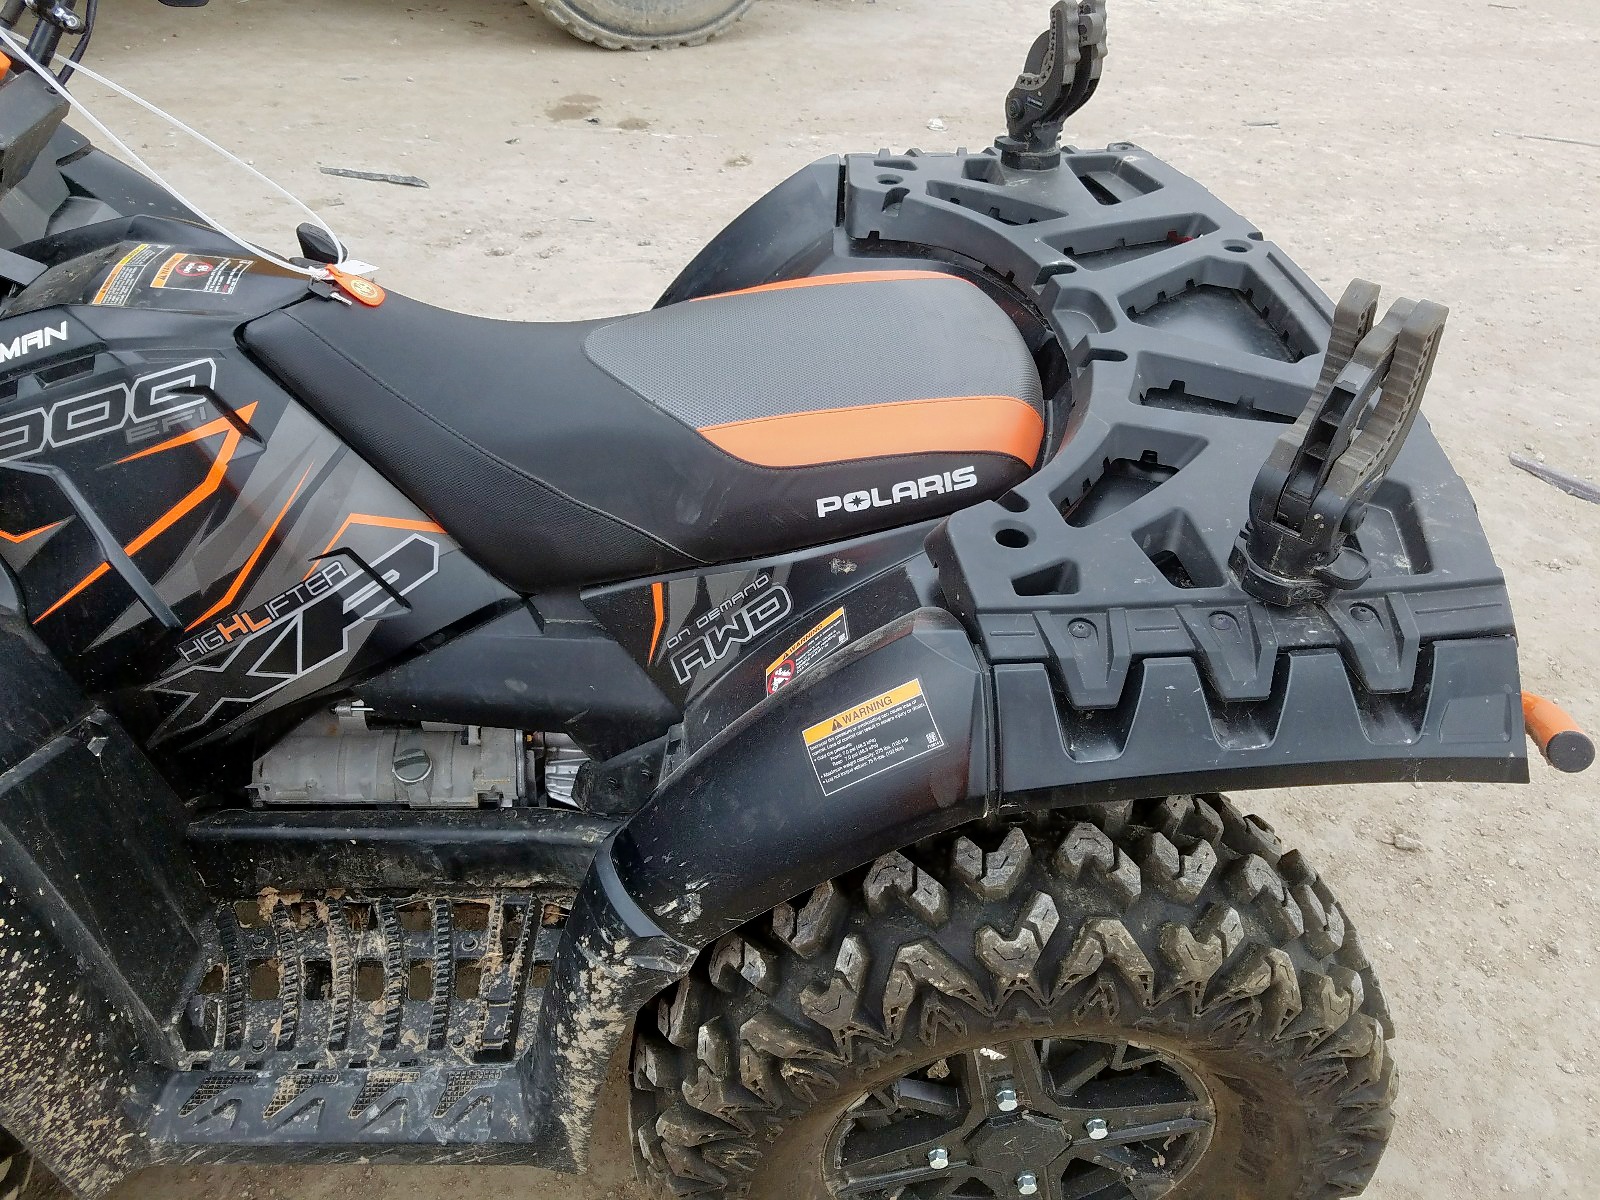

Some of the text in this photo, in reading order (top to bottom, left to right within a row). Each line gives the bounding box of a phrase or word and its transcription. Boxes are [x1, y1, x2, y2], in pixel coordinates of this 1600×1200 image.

[126, 406, 207, 444] EFI
[816, 465, 978, 518] POLARIS
[177, 559, 349, 662] HIGHLIFTER
[666, 574, 770, 649] ON DEMAND
[670, 585, 792, 684] AWD
[790, 624, 823, 653] WARNING
[842, 696, 894, 724] WARNING
